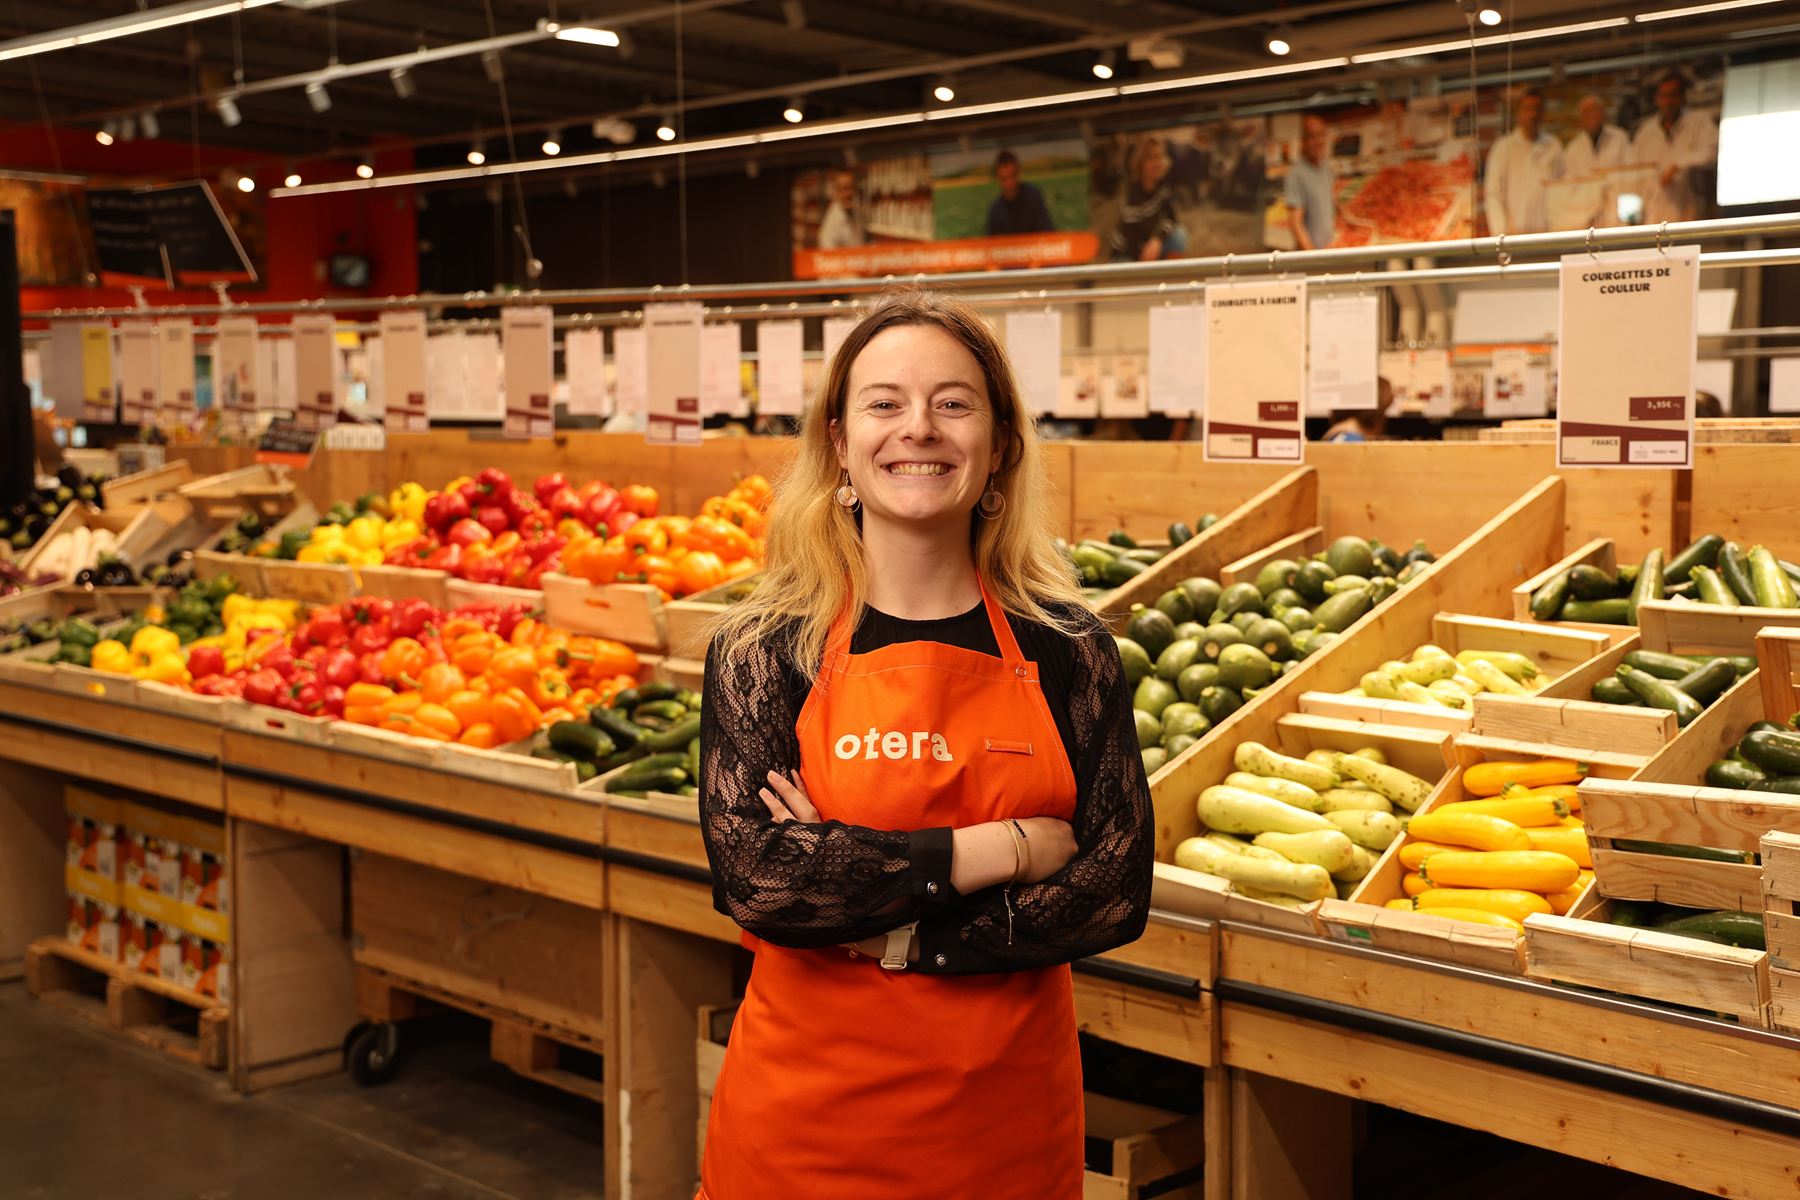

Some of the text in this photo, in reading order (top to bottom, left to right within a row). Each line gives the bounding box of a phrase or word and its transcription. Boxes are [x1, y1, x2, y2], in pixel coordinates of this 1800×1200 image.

[1582, 267, 1671, 282] COURGETTES DE
[1600, 282, 1650, 294] COULEUR
[1212, 297, 1257, 308] COURGETTE
[1267, 295, 1297, 305] FARCIR
[834, 727, 953, 762] otera
